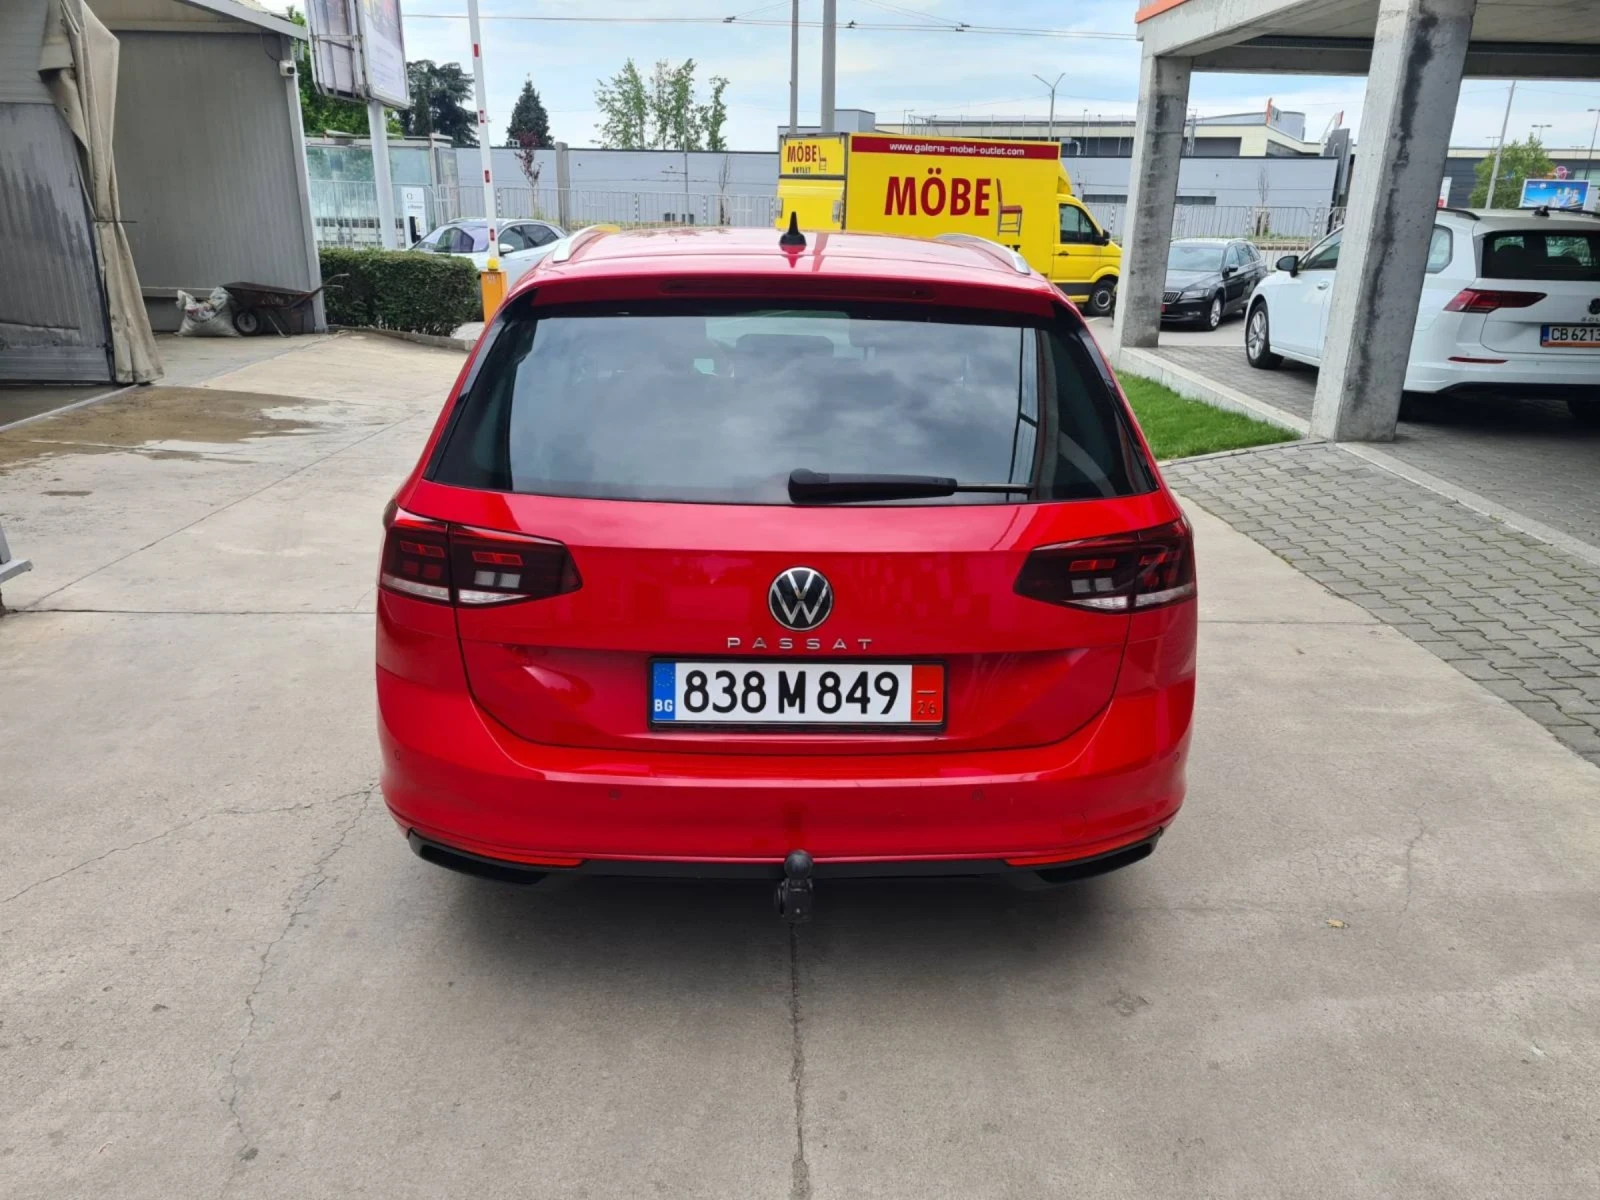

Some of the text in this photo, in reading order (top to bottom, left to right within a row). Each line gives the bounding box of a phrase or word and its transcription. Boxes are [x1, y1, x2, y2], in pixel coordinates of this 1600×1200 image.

[787, 141, 817, 163] MÖBE
[884, 167, 991, 216] MÖBE
[727, 637, 872, 650] PASSAT
[654, 700, 673, 712] BG
[684, 670, 766, 713] 838
[778, 671, 806, 714] M
[817, 671, 899, 715] 849
